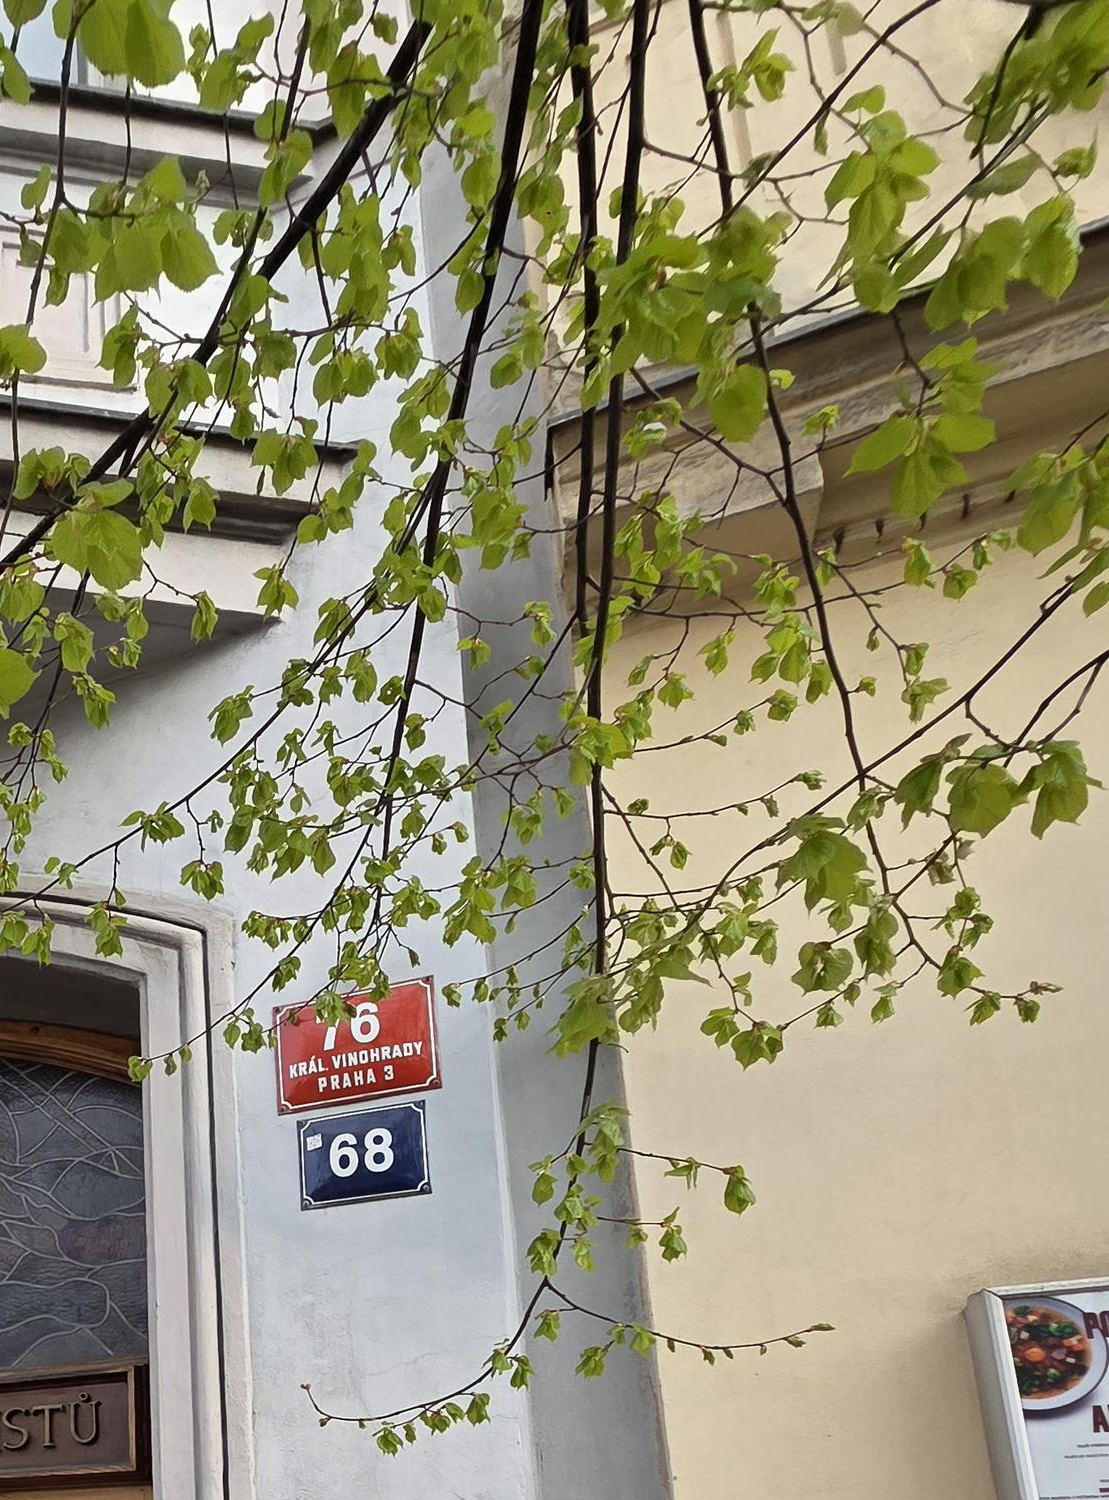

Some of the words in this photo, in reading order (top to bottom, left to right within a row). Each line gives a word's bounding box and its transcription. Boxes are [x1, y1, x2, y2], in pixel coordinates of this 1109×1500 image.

[289, 1056, 329, 1079] KRÁL.
[332, 1041, 424, 1069] VINOHRADY
[318, 1069, 377, 1093] PRAHA
[384, 1065, 395, 1081] 3
[329, 1127, 395, 1178] 68
